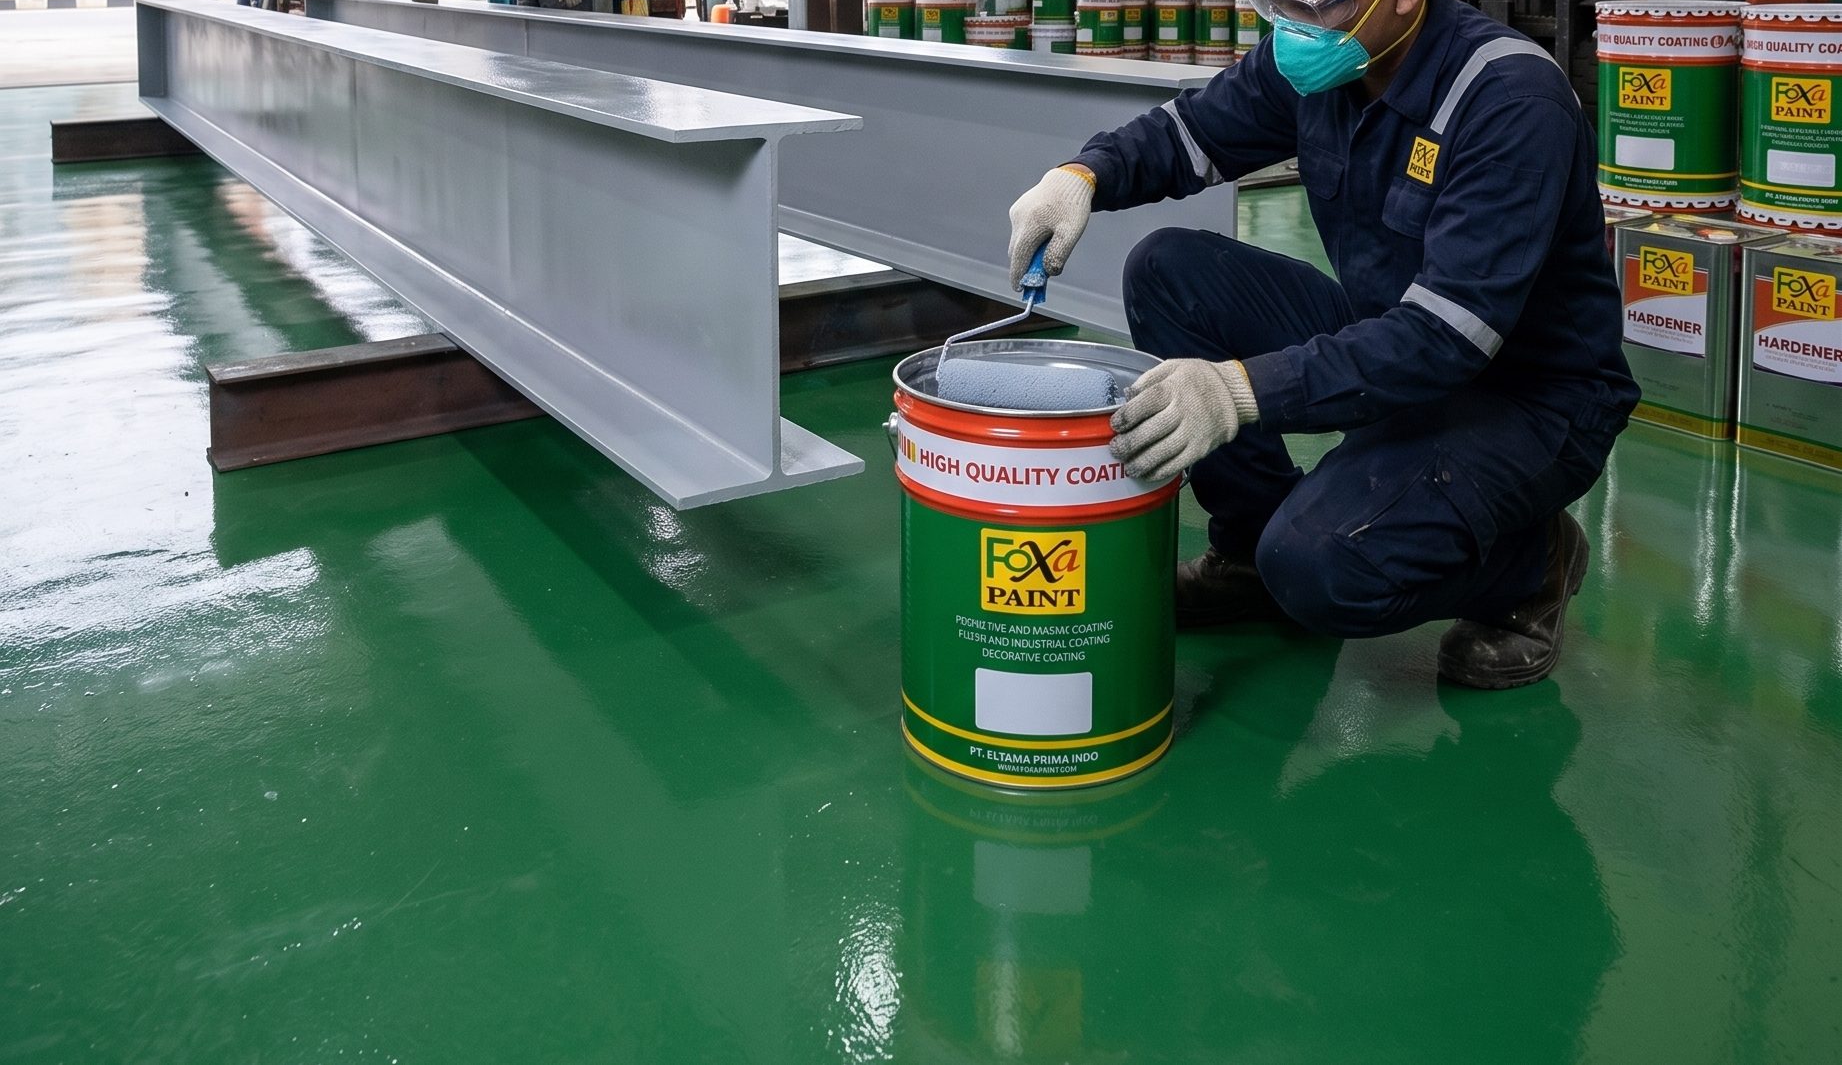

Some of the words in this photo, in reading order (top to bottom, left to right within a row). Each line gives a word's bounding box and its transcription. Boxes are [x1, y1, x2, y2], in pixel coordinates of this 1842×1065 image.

[1613, 34, 1654, 46] QUALITY
[1657, 36, 1708, 47] COATING
[1766, 41, 1814, 53] QUALITY
[1622, 93, 1667, 106] PAINT
[1775, 106, 1826, 119] PAINT
[1642, 273, 1689, 291] PAINT
[1776, 296, 1830, 317] PAINT
[1627, 309, 1702, 336] HARDENER
[1758, 334, 1842, 363] HARDENER
[920, 448, 960, 476] HIGH
[965, 461, 1060, 486] QUALITY
[1066, 462, 1130, 485] COATI
[986, 585, 1080, 608] PAINT
[1008, 625, 1031, 635] AND
[1071, 620, 1114, 634] COATING
[988, 636, 1010, 647] AND
[1011, 638, 1067, 649] INDUSTRIAL
[1068, 634, 1111, 648] COATING
[982, 647, 1041, 662] DECORATIVE
[1042, 651, 1086, 662] COATING
[970, 746, 985, 758] PT.
[987, 750, 1031, 764] ELTAMA
[1033, 754, 1069, 764] PRIMA
[1071, 752, 1099, 763] INDO
